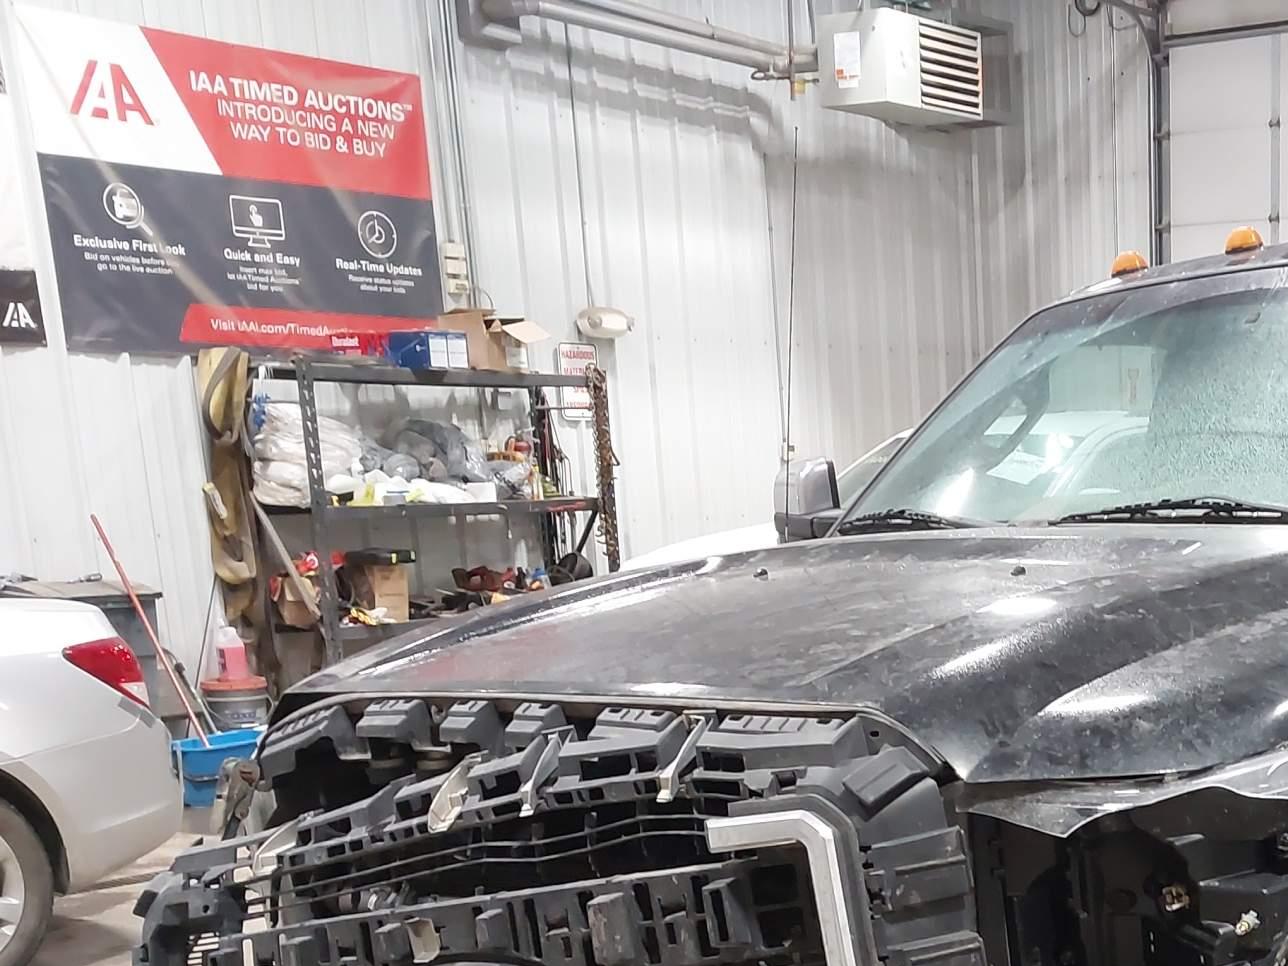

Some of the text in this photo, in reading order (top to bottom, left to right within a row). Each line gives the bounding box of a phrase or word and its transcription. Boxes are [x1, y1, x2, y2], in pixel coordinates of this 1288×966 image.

[189, 70, 227, 97] IAA
[229, 77, 298, 105] TIMED
[217, 99, 395, 140] INTRODUCING A NEW
[230, 122, 386, 158] WAY TO BID & BUY
[73, 234, 130, 251] Exclusive
[132, 240, 157, 253] First
[224, 248, 300, 267] Quick and Easy
[335, 258, 422, 276] Real-Time Updates
[210, 318, 235, 331] Visit
